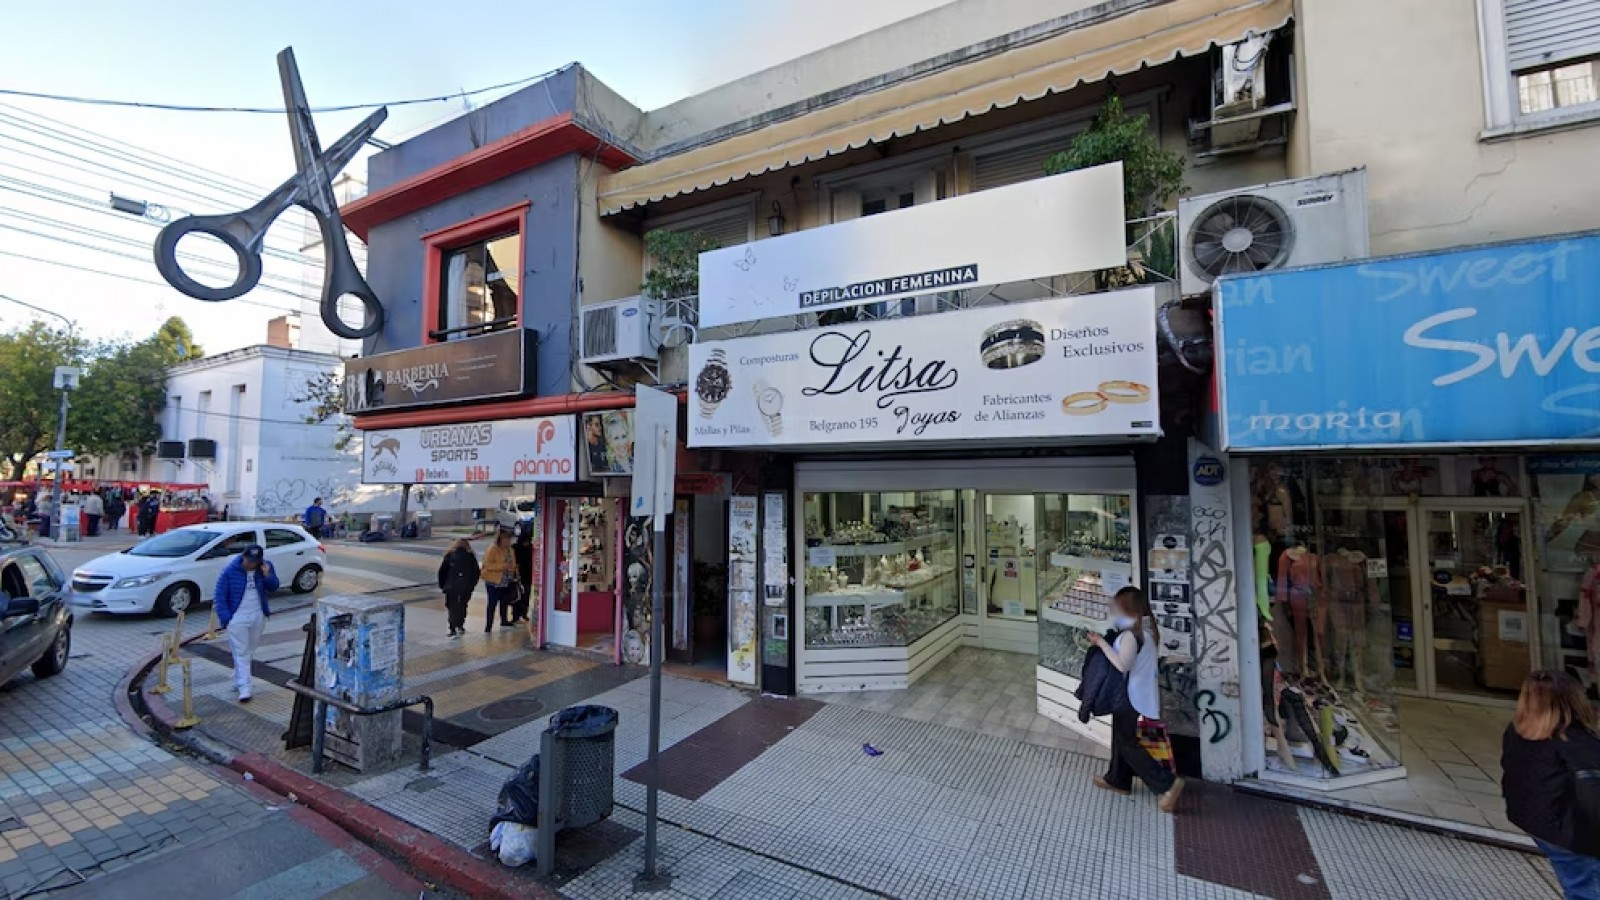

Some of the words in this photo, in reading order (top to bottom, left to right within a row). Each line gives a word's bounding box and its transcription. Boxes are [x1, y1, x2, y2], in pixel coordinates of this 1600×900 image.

[1357, 240, 1583, 302] Sweet
[803, 281, 886, 305] DEPILACION
[892, 267, 975, 291] FEMENINA
[1050, 326, 1110, 341] Diseños
[1063, 341, 1144, 358] Exclusivos
[739, 352, 799, 367] Composturas
[386, 363, 449, 386] BARBERIA
[801, 328, 959, 409] Litsa
[983, 393, 1052, 406] Fabricantes
[974, 412, 989, 422] de
[992, 409, 1045, 422] Alianzas
[695, 426, 721, 436] Mallas
[729, 424, 750, 435] Pilas
[809, 419, 857, 433] Belgrano
[860, 418, 878, 429] 195
[420, 424, 492, 449] URBANAS
[431, 449, 478, 462] SPORTS
[513, 455, 571, 480] pianino
